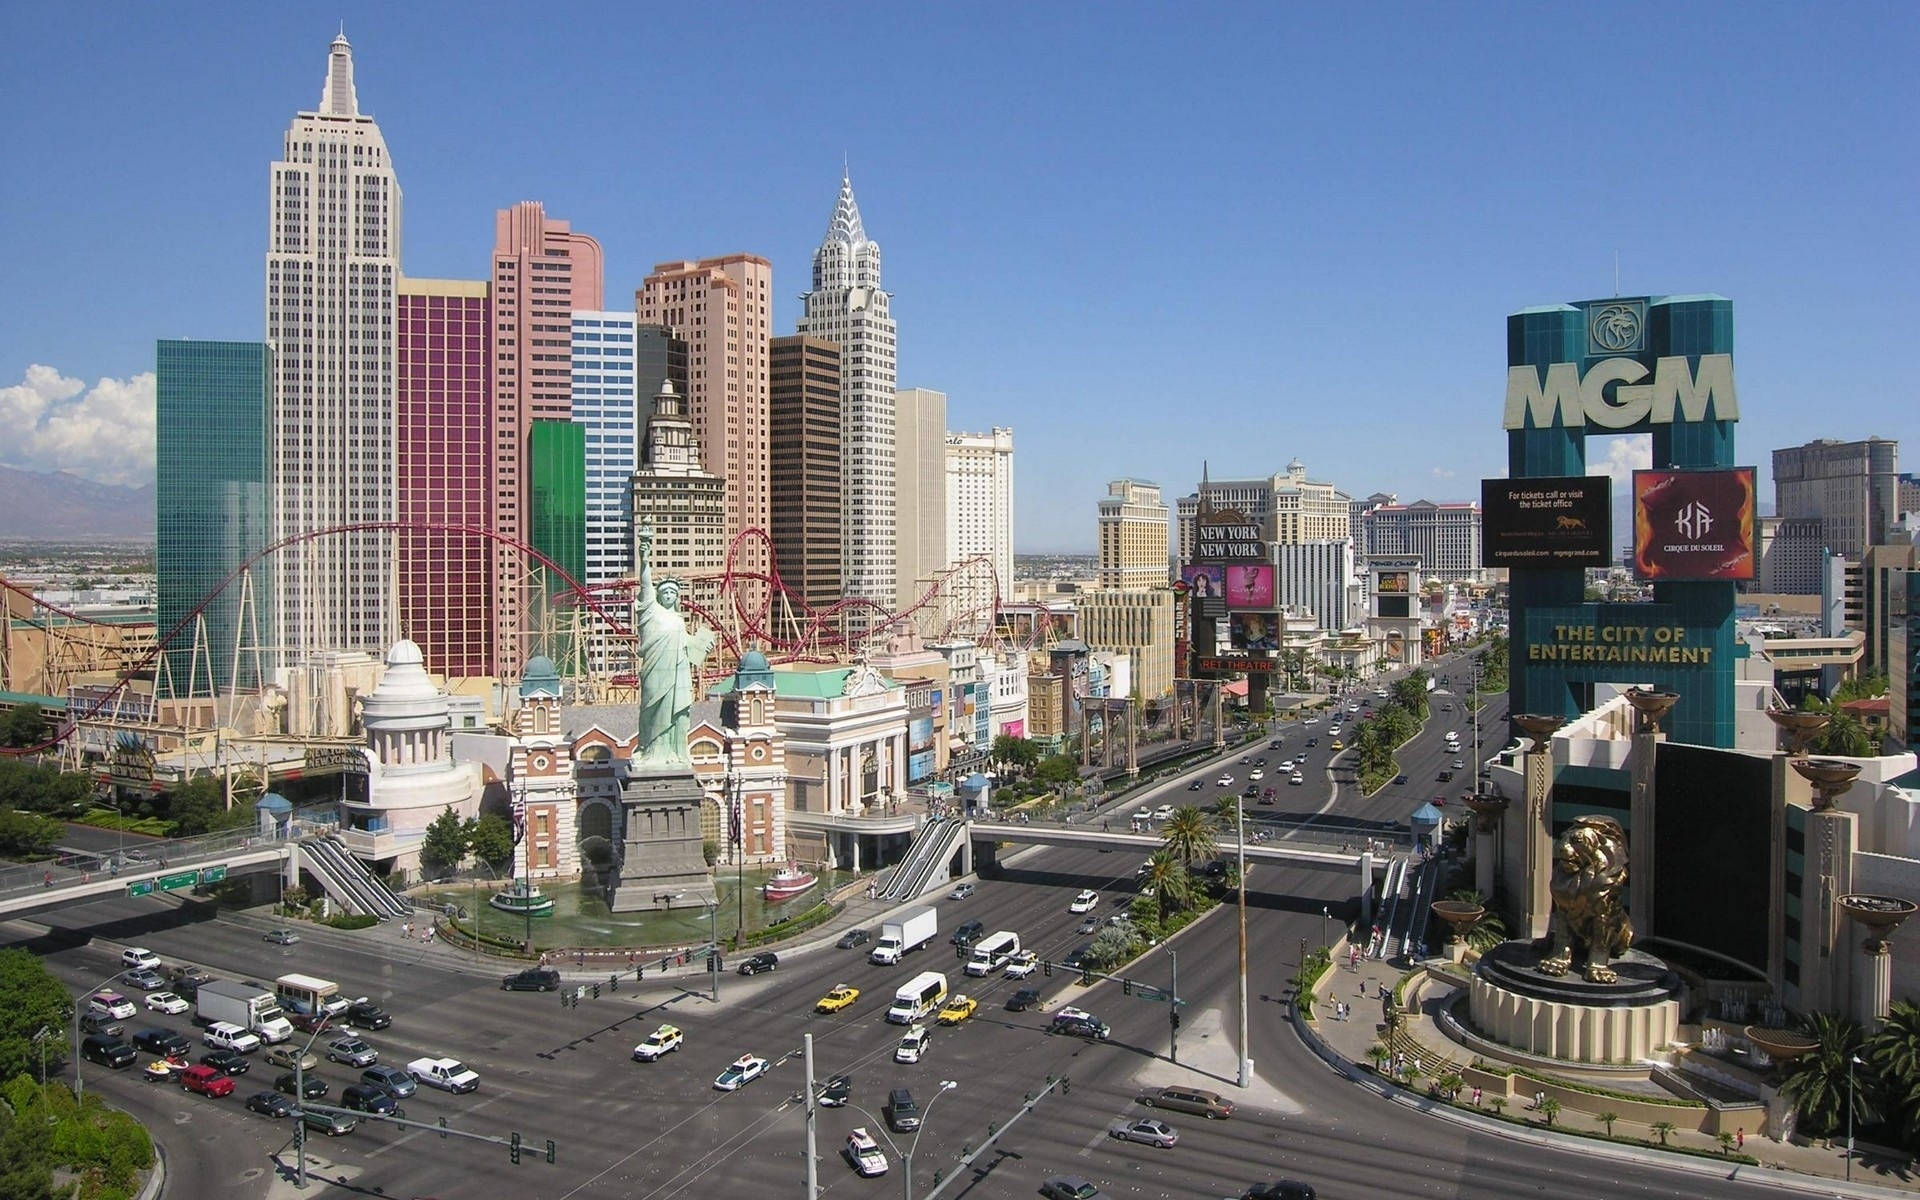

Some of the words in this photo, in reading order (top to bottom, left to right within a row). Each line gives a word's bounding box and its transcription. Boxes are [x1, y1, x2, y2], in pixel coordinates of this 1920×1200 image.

[1503, 354, 1740, 430] MGM
[1508, 491, 1520, 500] For
[1521, 491, 1544, 500] tickets
[1545, 490, 1559, 499] call
[1568, 490, 1583, 499] visit
[1519, 500, 1531, 509] the
[1532, 500, 1551, 508] ticket
[1553, 499, 1573, 508] office
[1200, 526, 1225, 540] NEW
[1228, 526, 1258, 540] YORK
[1200, 543, 1225, 557] NEW
[1228, 543, 1258, 557] YORK
[1664, 545, 1689, 553] CIRQUE
[1691, 544, 1700, 552] DU
[1701, 544, 1725, 552] SOLEIL
[1555, 625, 1595, 642] THE
[1602, 626, 1648, 642] CITY
[1654, 627, 1685, 643] OF
[1529, 644, 1712, 664] ENTERTAINMENT
[1227, 660, 1273, 671] THEATRE
